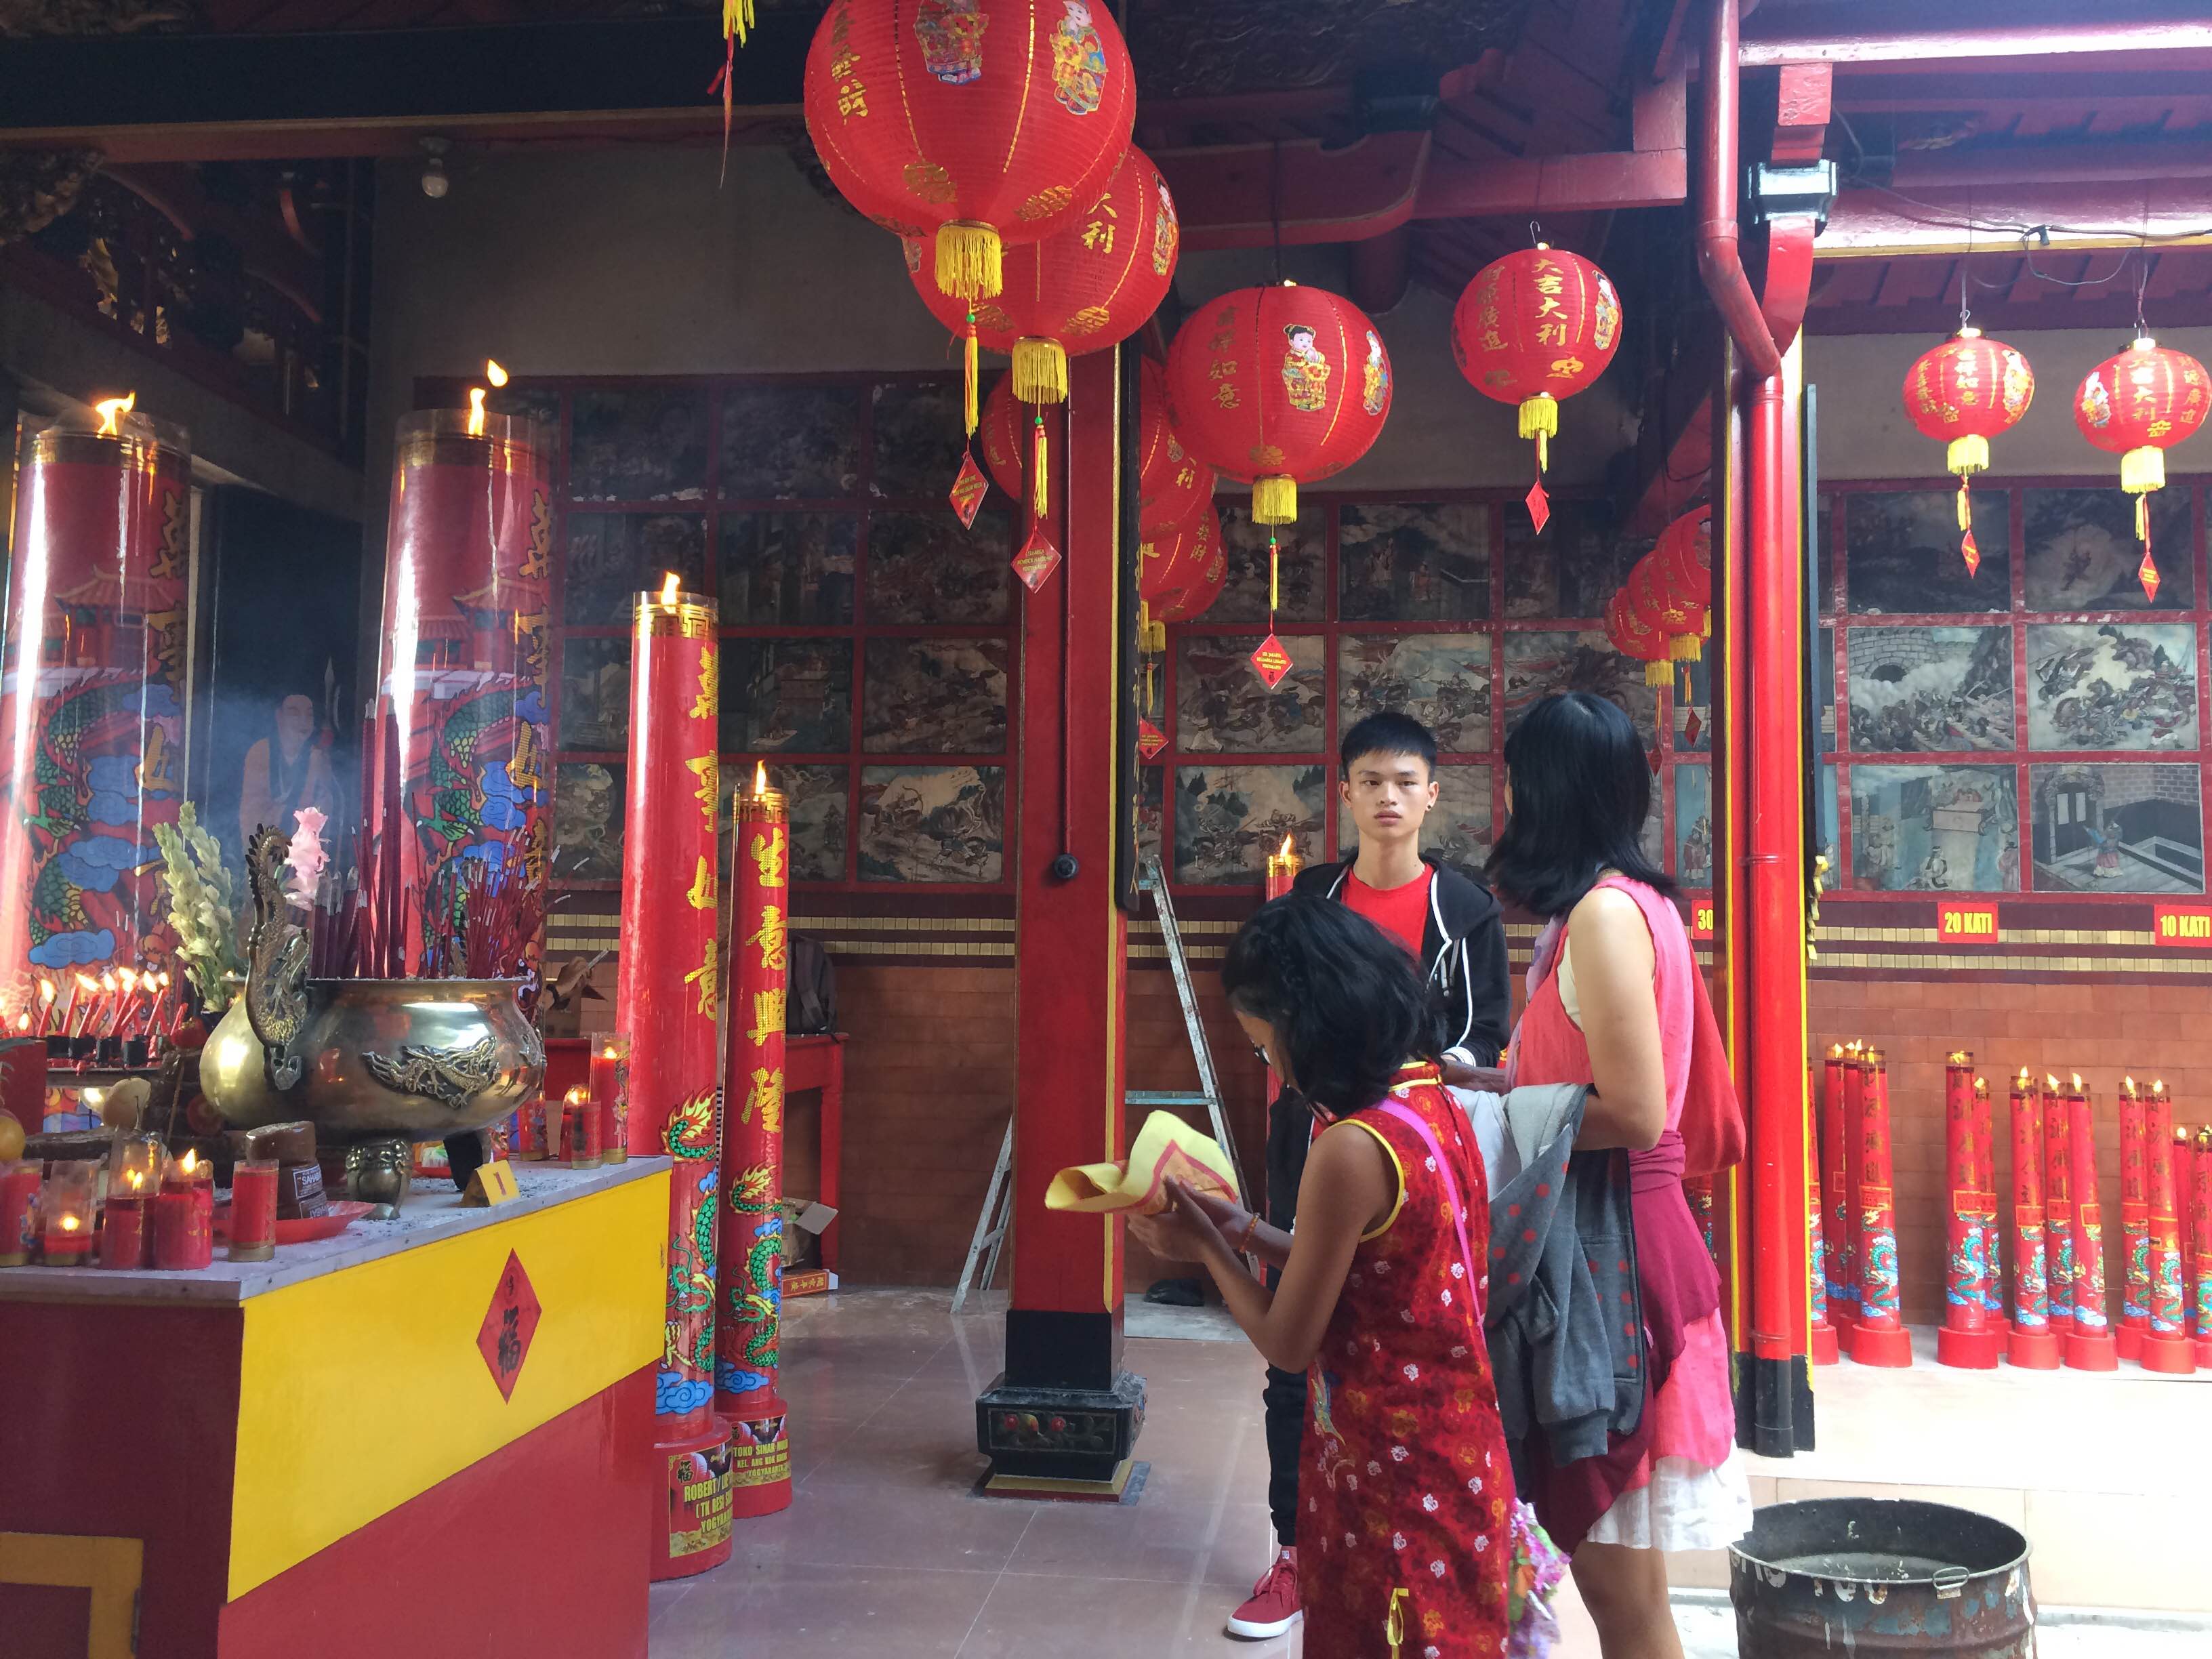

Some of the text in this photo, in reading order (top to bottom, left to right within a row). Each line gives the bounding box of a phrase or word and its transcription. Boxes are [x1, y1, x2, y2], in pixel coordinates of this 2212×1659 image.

[1532, 258, 1568, 347] 大吉大利
[1698, 909, 1713, 930] 30
[1944, 912, 1992, 934] 20 KATI
[2160, 915, 2211, 938] 10 KATI
[733, 1446, 753, 1458] TOKO
